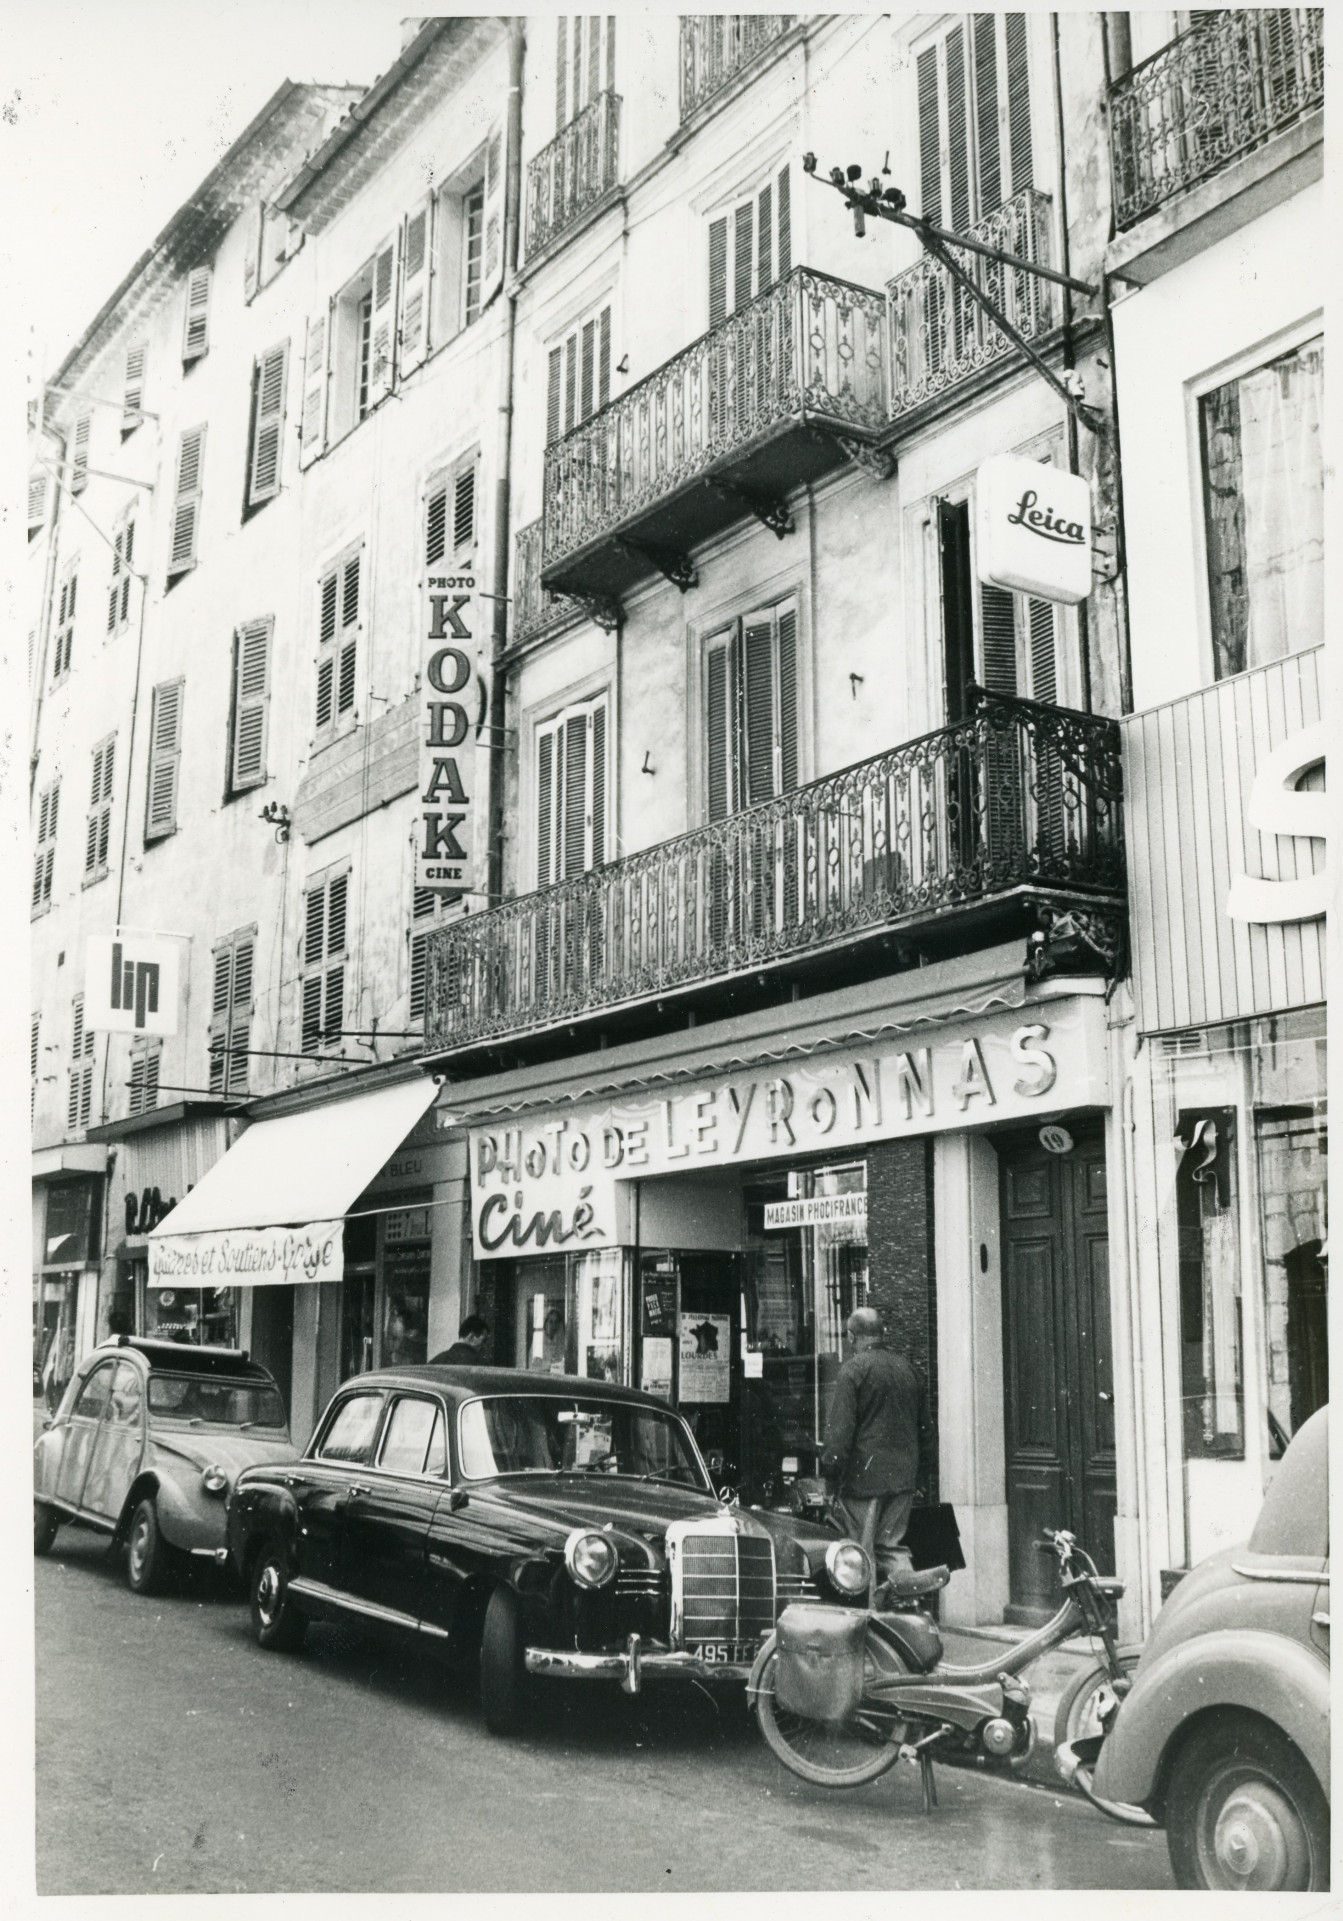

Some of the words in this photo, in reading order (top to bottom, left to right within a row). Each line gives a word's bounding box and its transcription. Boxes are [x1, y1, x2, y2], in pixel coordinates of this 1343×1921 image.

[1007, 490, 1086, 544] Leica
[427, 576, 476, 589] PHOTO
[422, 594, 472, 860] KODAK
[425, 867, 463, 880] CINE
[478, 1121, 591, 1188] PHOTO
[603, 1121, 649, 1168] DE
[660, 1023, 1058, 1159] LEYRONNAS
[390, 1160, 422, 1177] BLEU
[479, 1185, 606, 1250] Ciné
[766, 1204, 804, 1225] MAGASIN
[201, 1249, 217, 1275] et
[693, 1645, 728, 1662] 495
